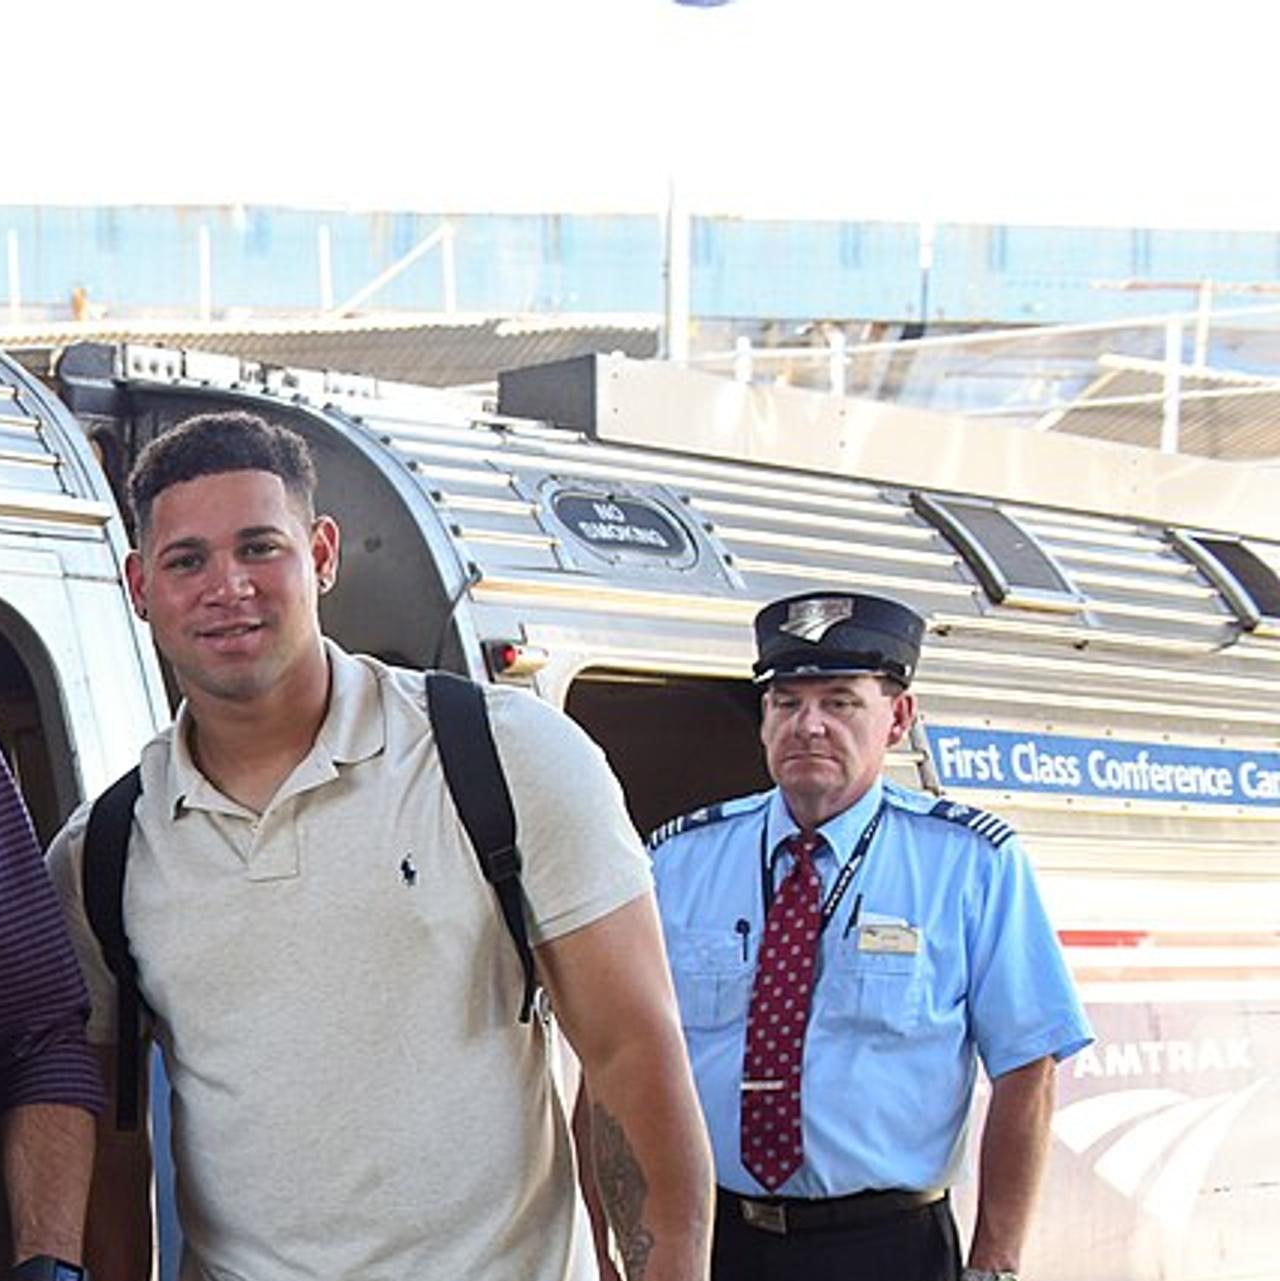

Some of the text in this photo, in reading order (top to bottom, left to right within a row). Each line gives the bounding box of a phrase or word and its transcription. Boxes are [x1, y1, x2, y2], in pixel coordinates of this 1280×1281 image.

[592, 502, 625, 523] NO
[578, 521, 669, 548] SMOKING
[938, 736, 1003, 782] First
[1012, 741, 1080, 787] Class
[1089, 750, 1232, 796] Conference
[1074, 1037, 1252, 1079] AMTRAK
